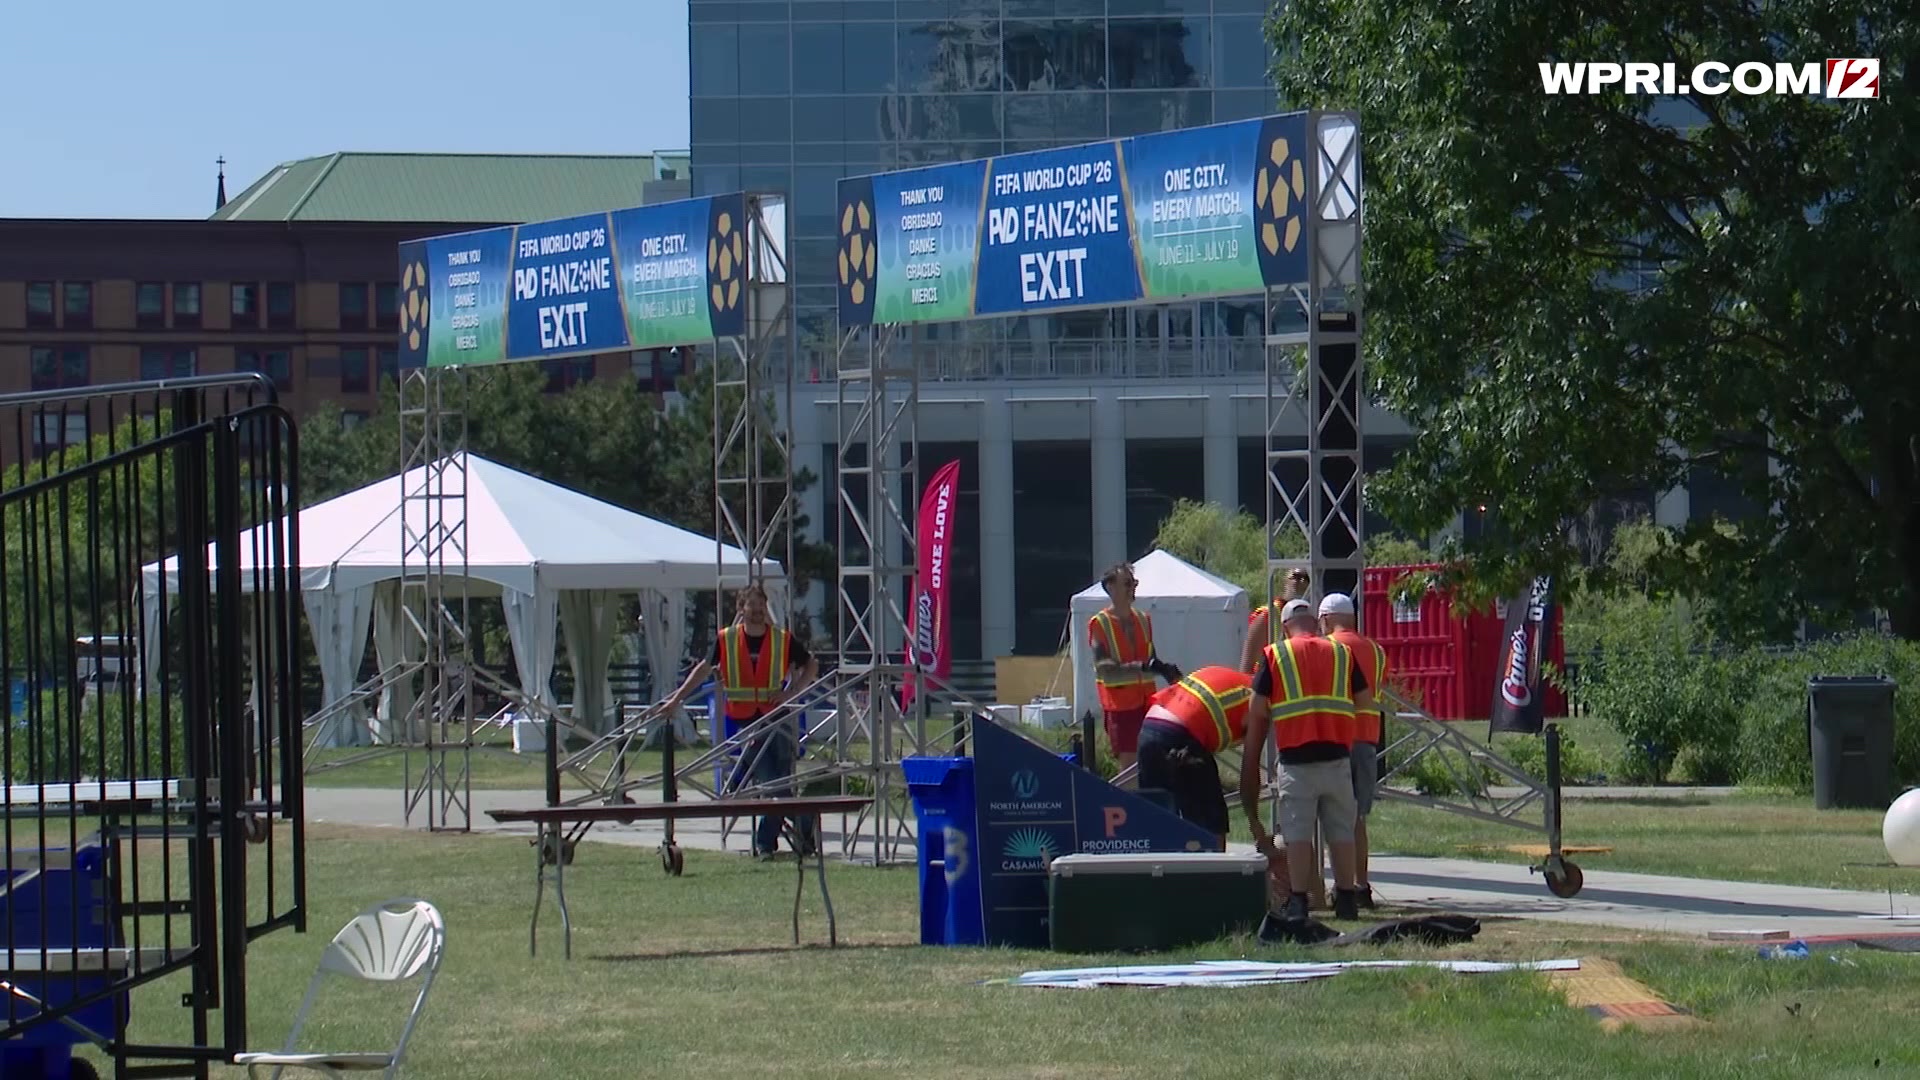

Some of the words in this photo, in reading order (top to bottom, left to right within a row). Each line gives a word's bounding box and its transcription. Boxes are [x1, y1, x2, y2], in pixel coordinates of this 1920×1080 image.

[995, 173, 1021, 196] FIFA
[1023, 167, 1065, 193] WORLD
[1067, 163, 1091, 188] CUP
[1165, 168, 1191, 193] ONE
[1194, 163, 1228, 189] CITY.
[900, 189, 926, 206] THANK
[928, 186, 944, 202] YOU
[1153, 199, 1192, 223] EVERY
[1195, 191, 1243, 217] MATCH.
[901, 211, 942, 230] OBRIGADO
[519, 239, 539, 258] FIFA
[541, 234, 572, 256] WORLD
[573, 231, 590, 251] CUP
[642, 238, 661, 256] ONE
[663, 234, 687, 254] CITY.
[909, 237, 936, 254] DANKE
[1158, 245, 1183, 266] JUNE
[448, 251, 468, 266] THANK
[469, 249, 480, 263] YOU
[635, 262, 662, 283] EVERY
[664, 258, 698, 278] MATCH.
[906, 262, 941, 280] GRACIAS
[1020, 248, 1087, 303] EXIT
[911, 287, 938, 304] MERCI
[539, 302, 588, 349] EXIT
[935, 485, 950, 540] LOVE
[932, 545, 944, 588] ONE
[1020, 801, 1062, 810] AMERICAN
[1104, 807, 1127, 837] P
[1082, 839, 1151, 850] PROVIDENCE
